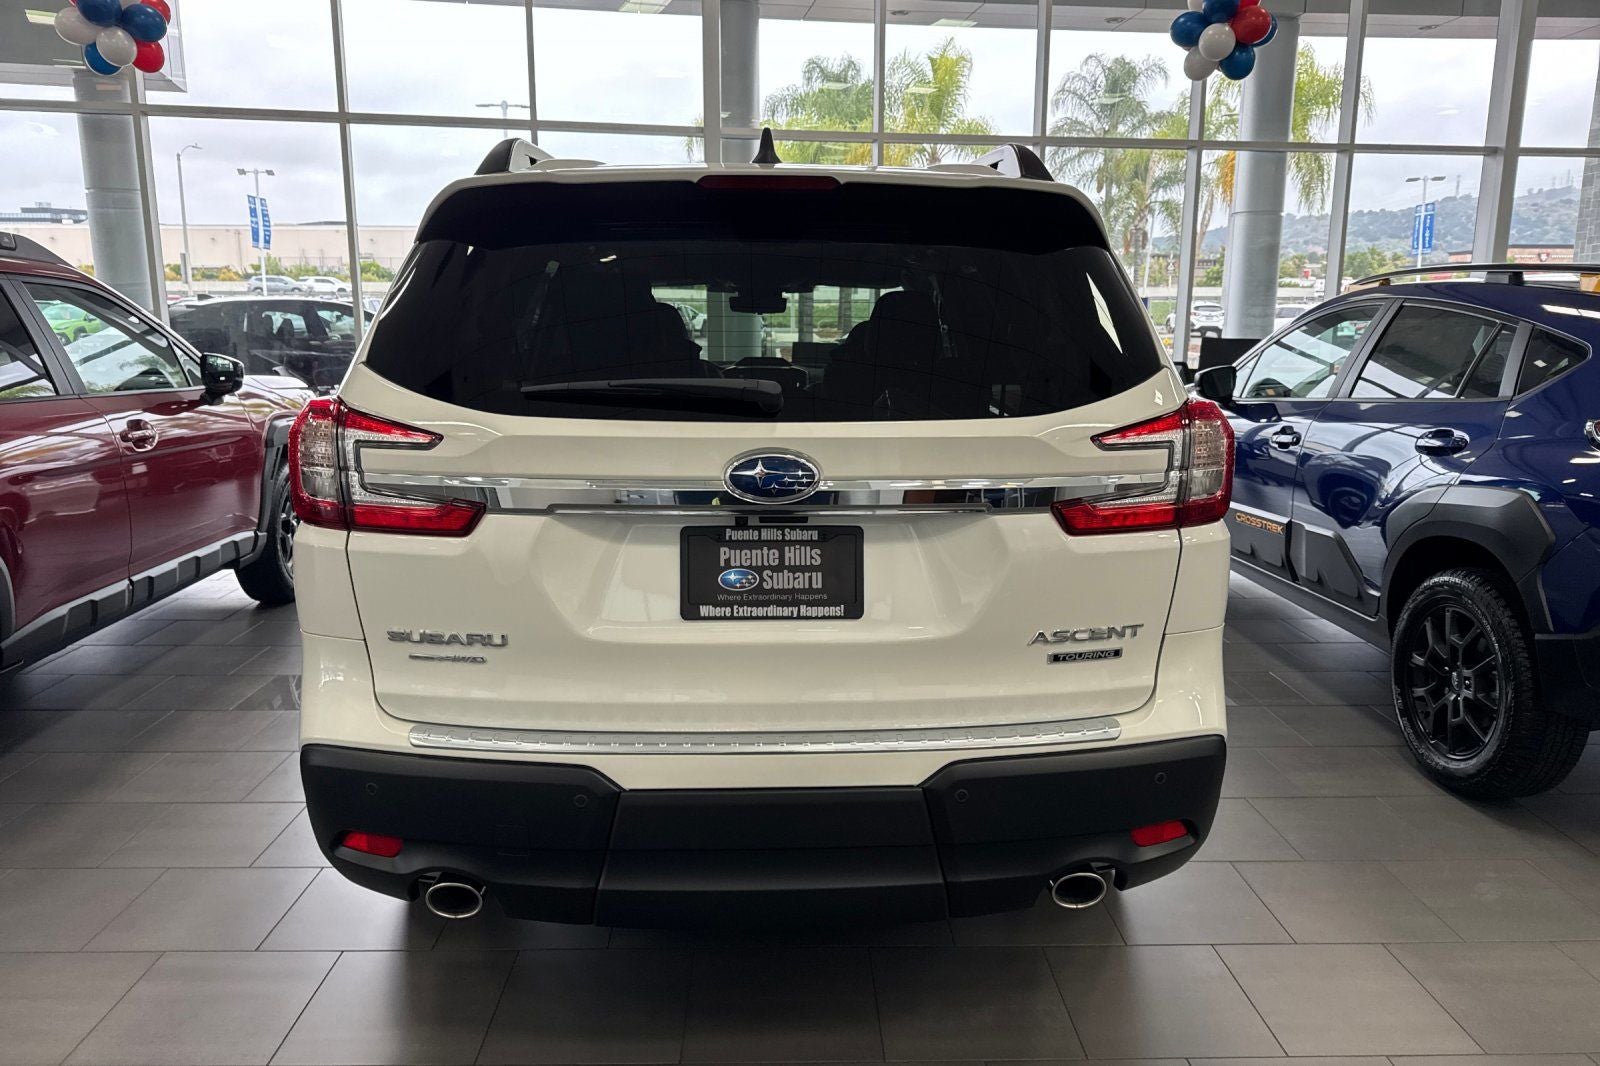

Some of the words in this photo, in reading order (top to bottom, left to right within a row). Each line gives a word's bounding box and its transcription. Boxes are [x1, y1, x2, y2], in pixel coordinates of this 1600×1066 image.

[1235, 512, 1284, 535] CROSSTREK
[725, 528, 759, 540] Puente
[761, 528, 782, 540] Hills
[784, 528, 818, 540] Subaru
[720, 546, 779, 566] Puente
[785, 544, 821, 566] Hills
[762, 569, 822, 589] Subaru
[717, 593, 741, 601] Where
[743, 593, 792, 601] Extraordinary
[794, 593, 828, 601] Happens
[700, 605, 731, 617] Where
[733, 604, 798, 617] Extraordinary
[800, 604, 844, 617] Happens!
[386, 629, 508, 647] SUBARU
[1027, 624, 1144, 646] ASCENT
[1057, 650, 1115, 661] TOURING
